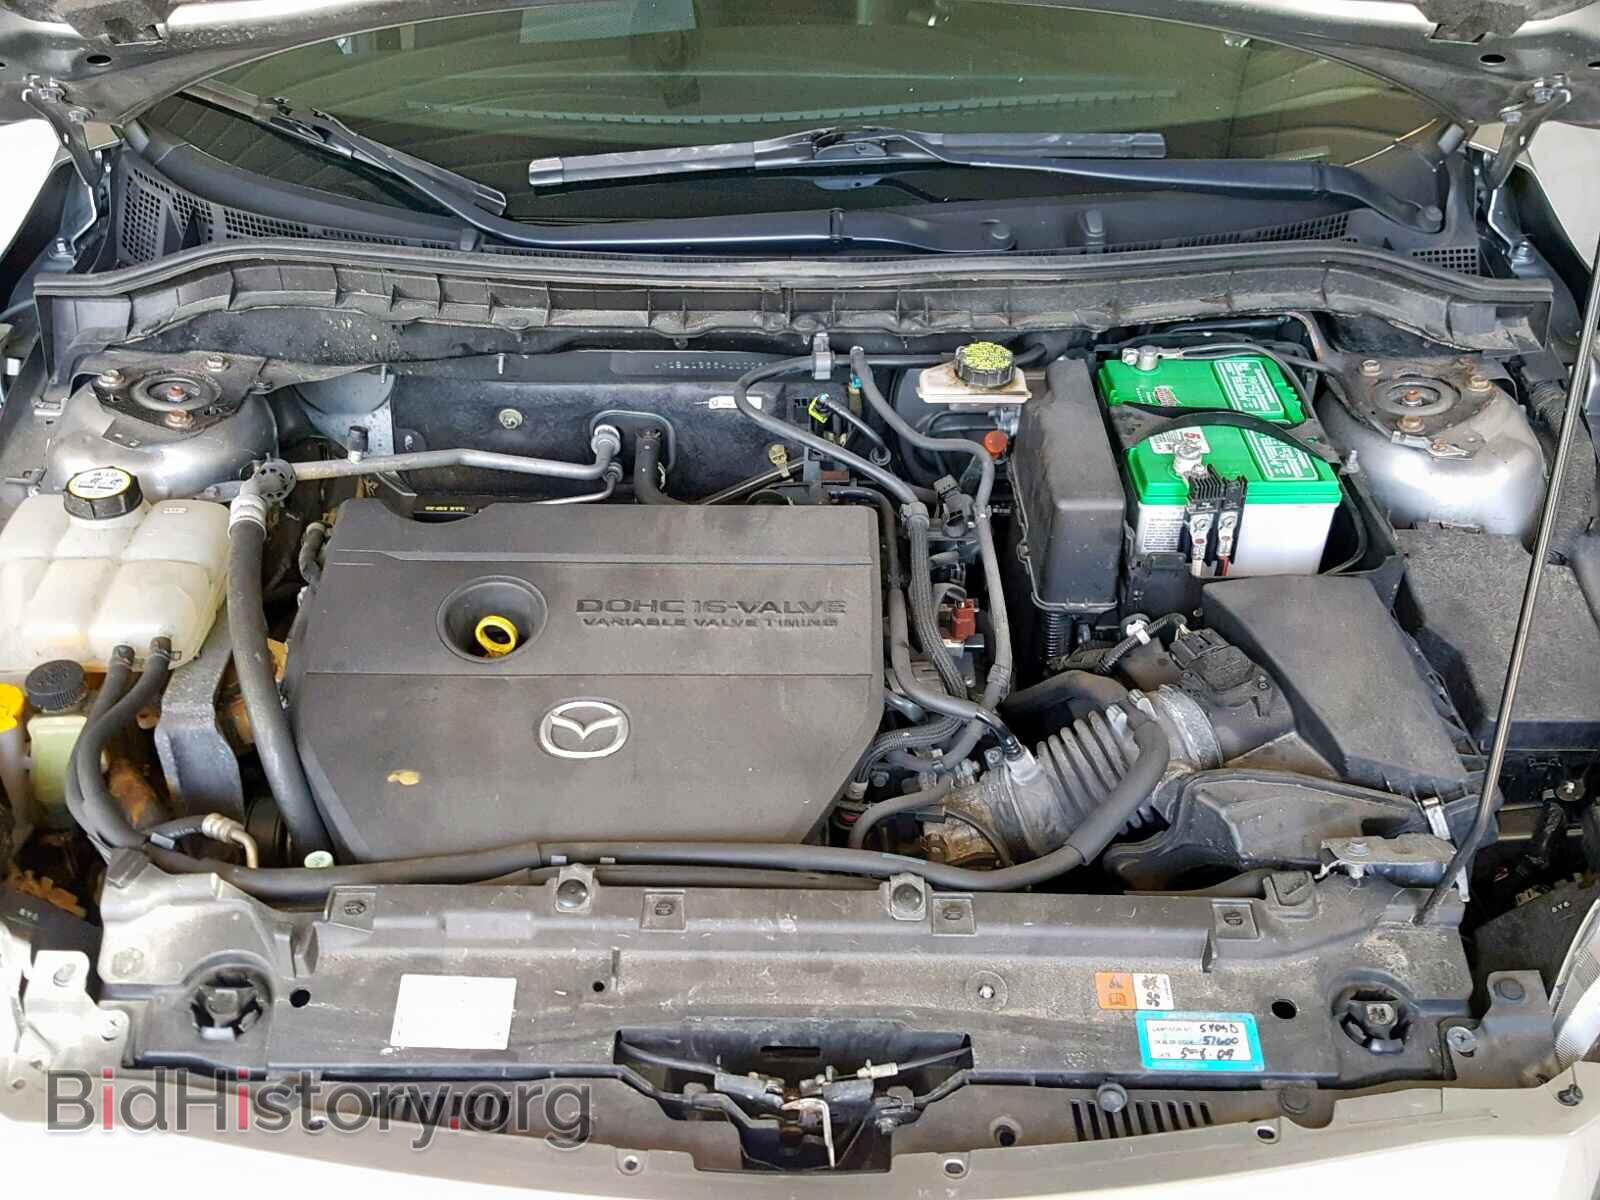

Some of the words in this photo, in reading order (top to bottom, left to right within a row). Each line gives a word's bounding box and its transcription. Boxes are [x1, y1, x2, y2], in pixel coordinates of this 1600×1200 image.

[576, 599, 685, 614] DOHC
[693, 600, 848, 614] 16-VALVE
[582, 617, 688, 628] VARIABLE
[693, 617, 760, 628] VALVE
[764, 617, 839, 628] TIMING
